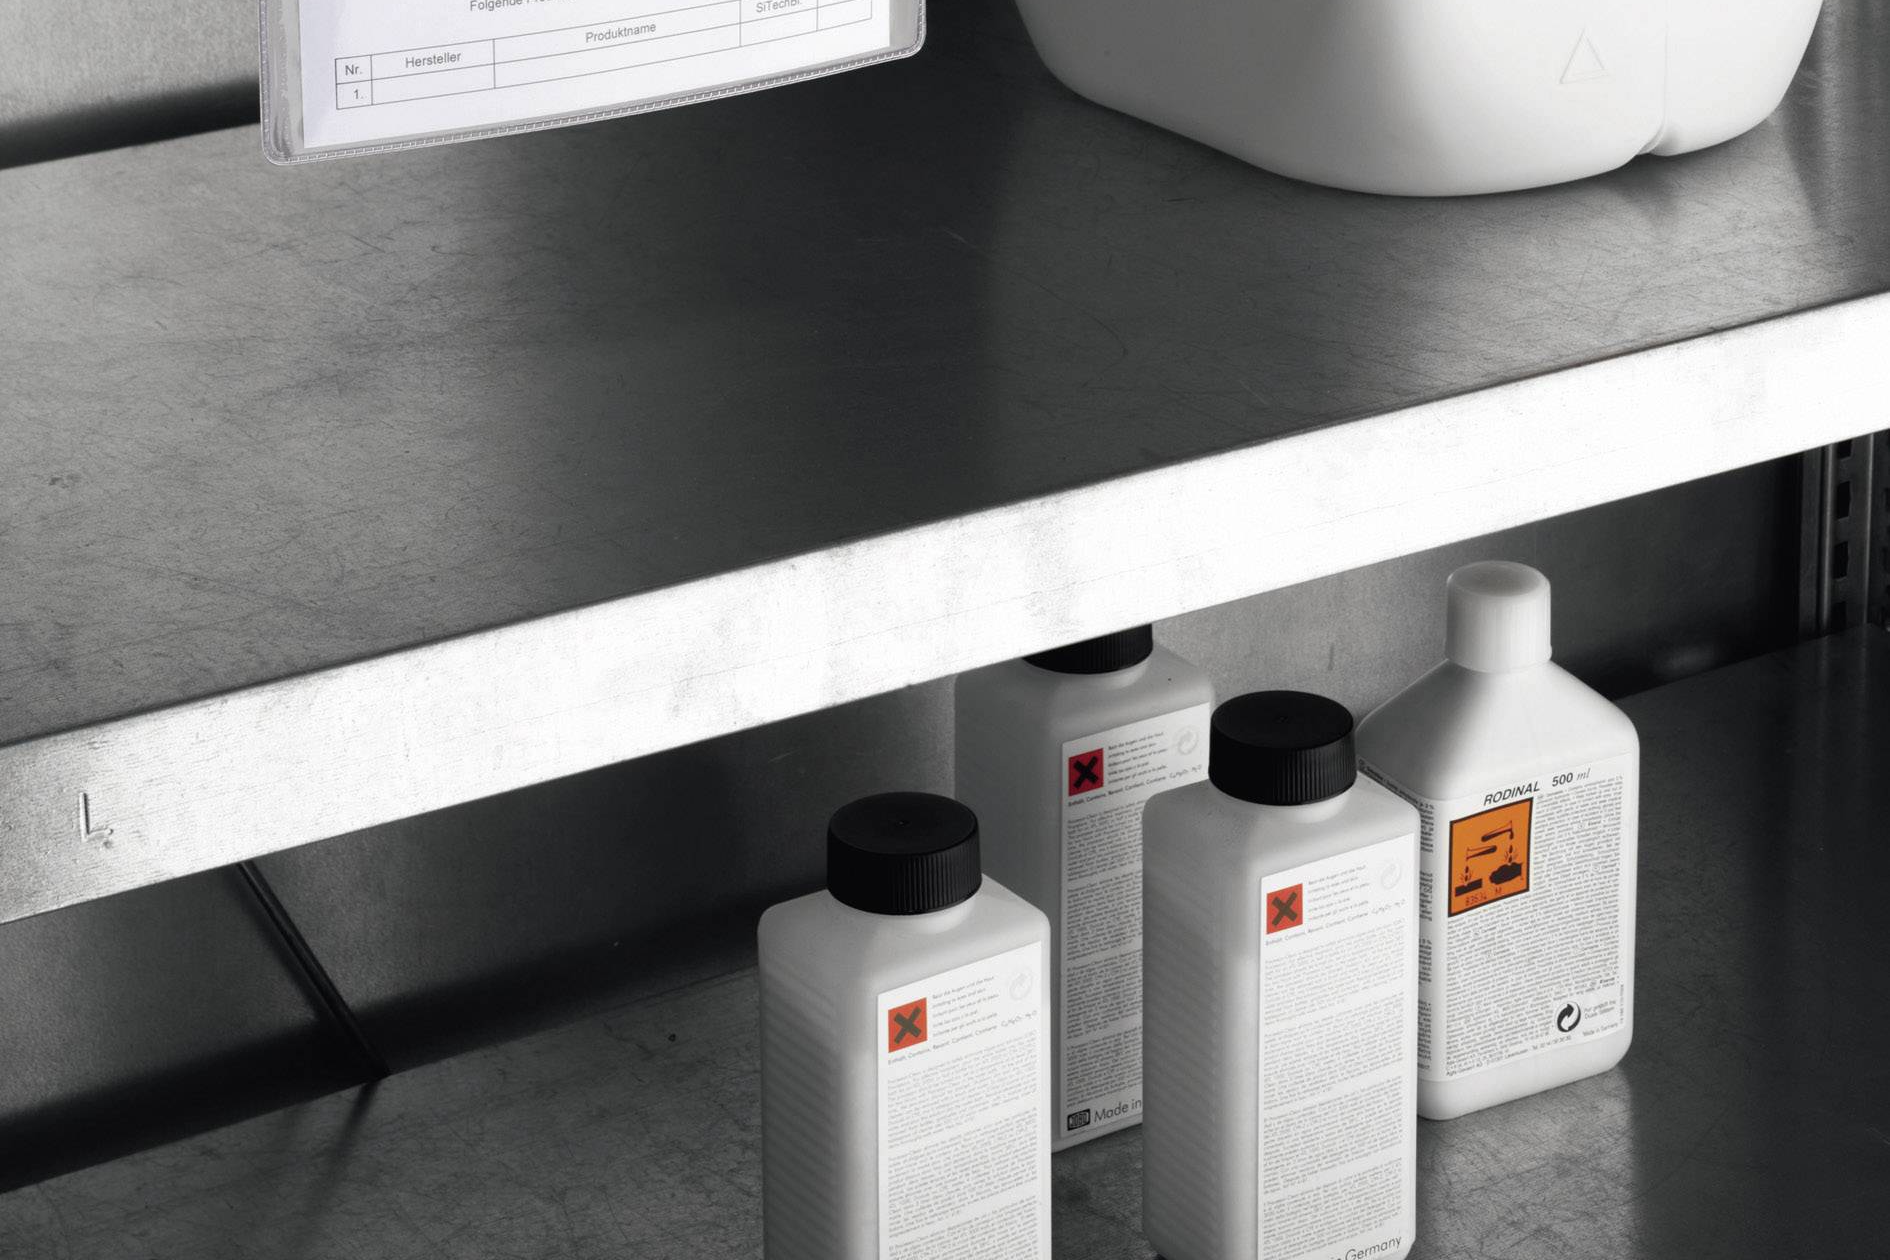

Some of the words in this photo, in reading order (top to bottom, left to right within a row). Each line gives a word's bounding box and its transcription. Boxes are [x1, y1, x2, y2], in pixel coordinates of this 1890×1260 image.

[345, 64, 363, 76] Nr.
[405, 52, 461, 68] Hersteller
[586, 22, 656, 43] Produktname
[1484, 781, 1540, 806] RODINAL
[1552, 772, 1573, 787] 500
[1576, 768, 1591, 781] ml
[1095, 1102, 1128, 1123] Made
[1132, 1099, 1142, 1109] in
[1345, 1236, 1402, 1260] Germany
